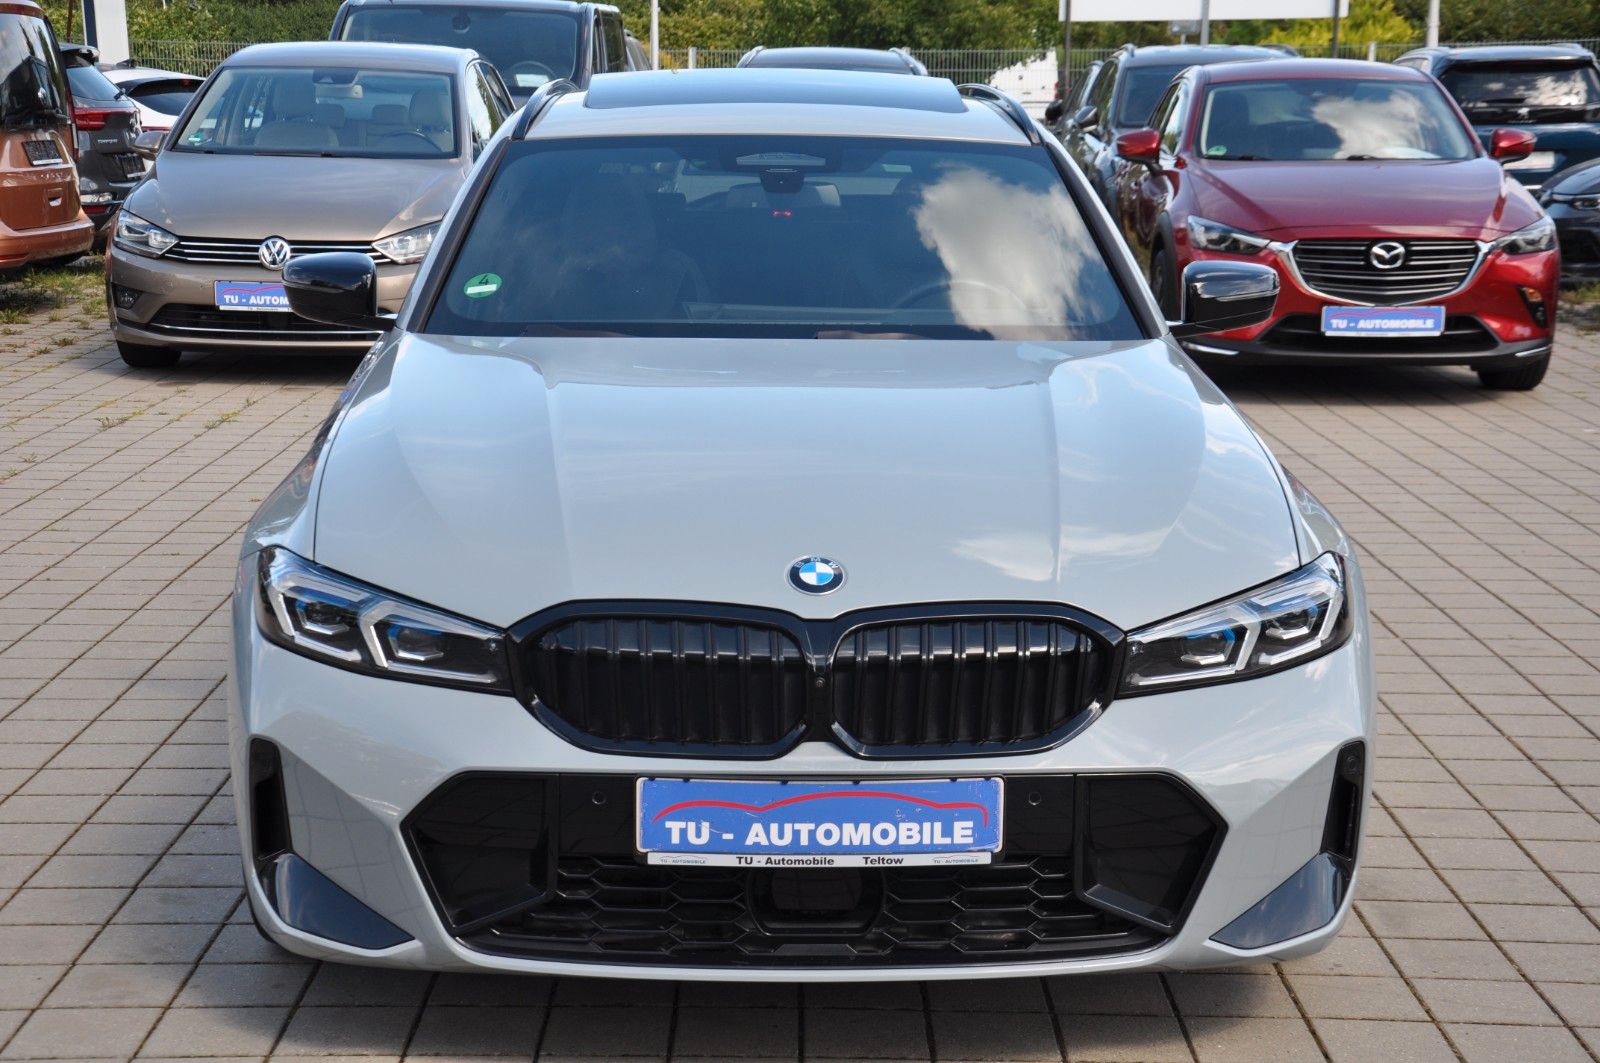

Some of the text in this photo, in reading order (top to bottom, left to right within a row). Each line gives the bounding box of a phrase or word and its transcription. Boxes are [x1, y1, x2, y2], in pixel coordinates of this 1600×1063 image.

[479, 274, 489, 285] 4
[224, 295, 239, 304] TU
[249, 296, 290, 305] AUTOM
[1330, 319, 1348, 329] TU
[1357, 319, 1435, 329] AUTOMOBILE
[794, 556, 840, 569] BMW
[665, 820, 710, 845] TU
[744, 820, 974, 846] AUTOMOBILE
[736, 856, 754, 866] TU
[765, 856, 835, 866] Automobile
[862, 856, 904, 866] Teltow
